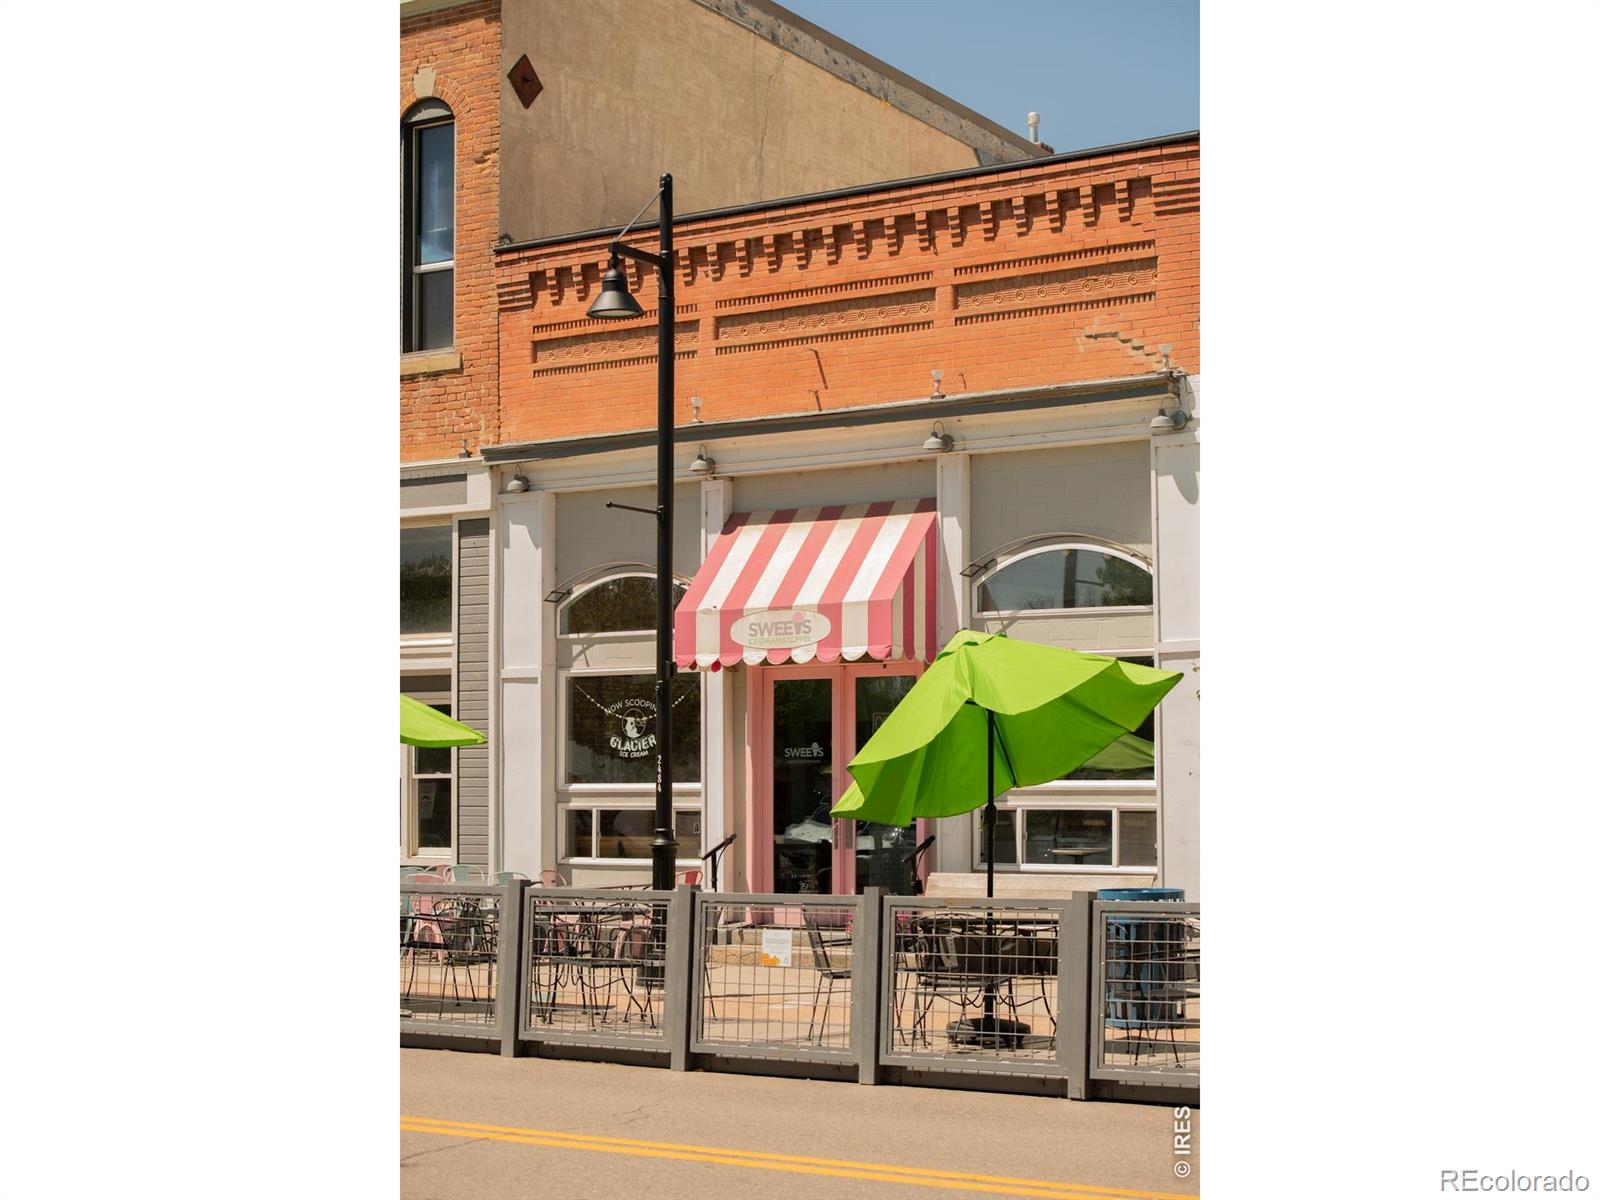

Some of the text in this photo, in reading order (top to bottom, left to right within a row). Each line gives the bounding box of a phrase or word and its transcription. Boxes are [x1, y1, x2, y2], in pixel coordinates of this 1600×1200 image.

[624, 699, 657, 712] SCOOPIN
[610, 734, 657, 751] GLACIER
[630, 750, 649, 758] CREAM
